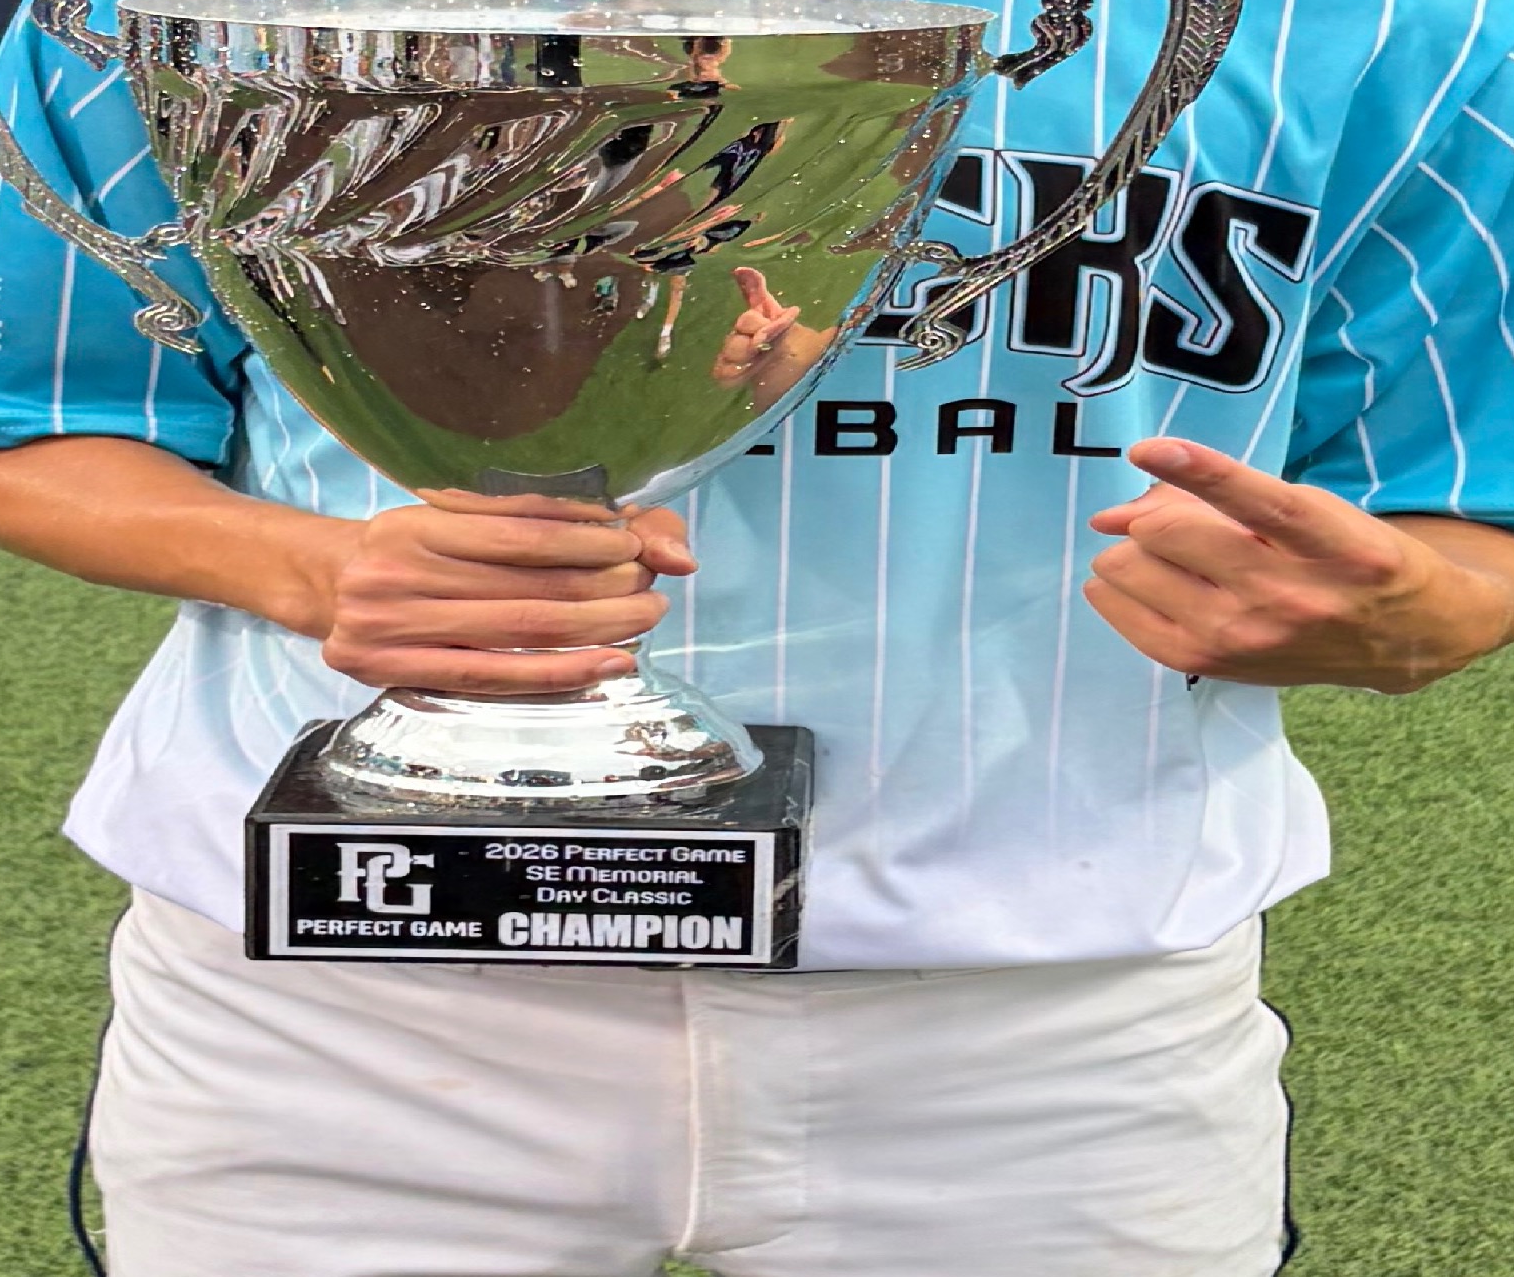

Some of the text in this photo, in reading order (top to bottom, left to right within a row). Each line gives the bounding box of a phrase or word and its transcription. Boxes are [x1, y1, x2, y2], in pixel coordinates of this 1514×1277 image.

[744, 398, 1122, 458] BAL
[485, 843, 559, 861] 2026
[335, 842, 435, 915] PG
[526, 866, 562, 882] SE
[296, 918, 483, 938] PERFECT GAME
[497, 911, 743, 950] CHAMPION
